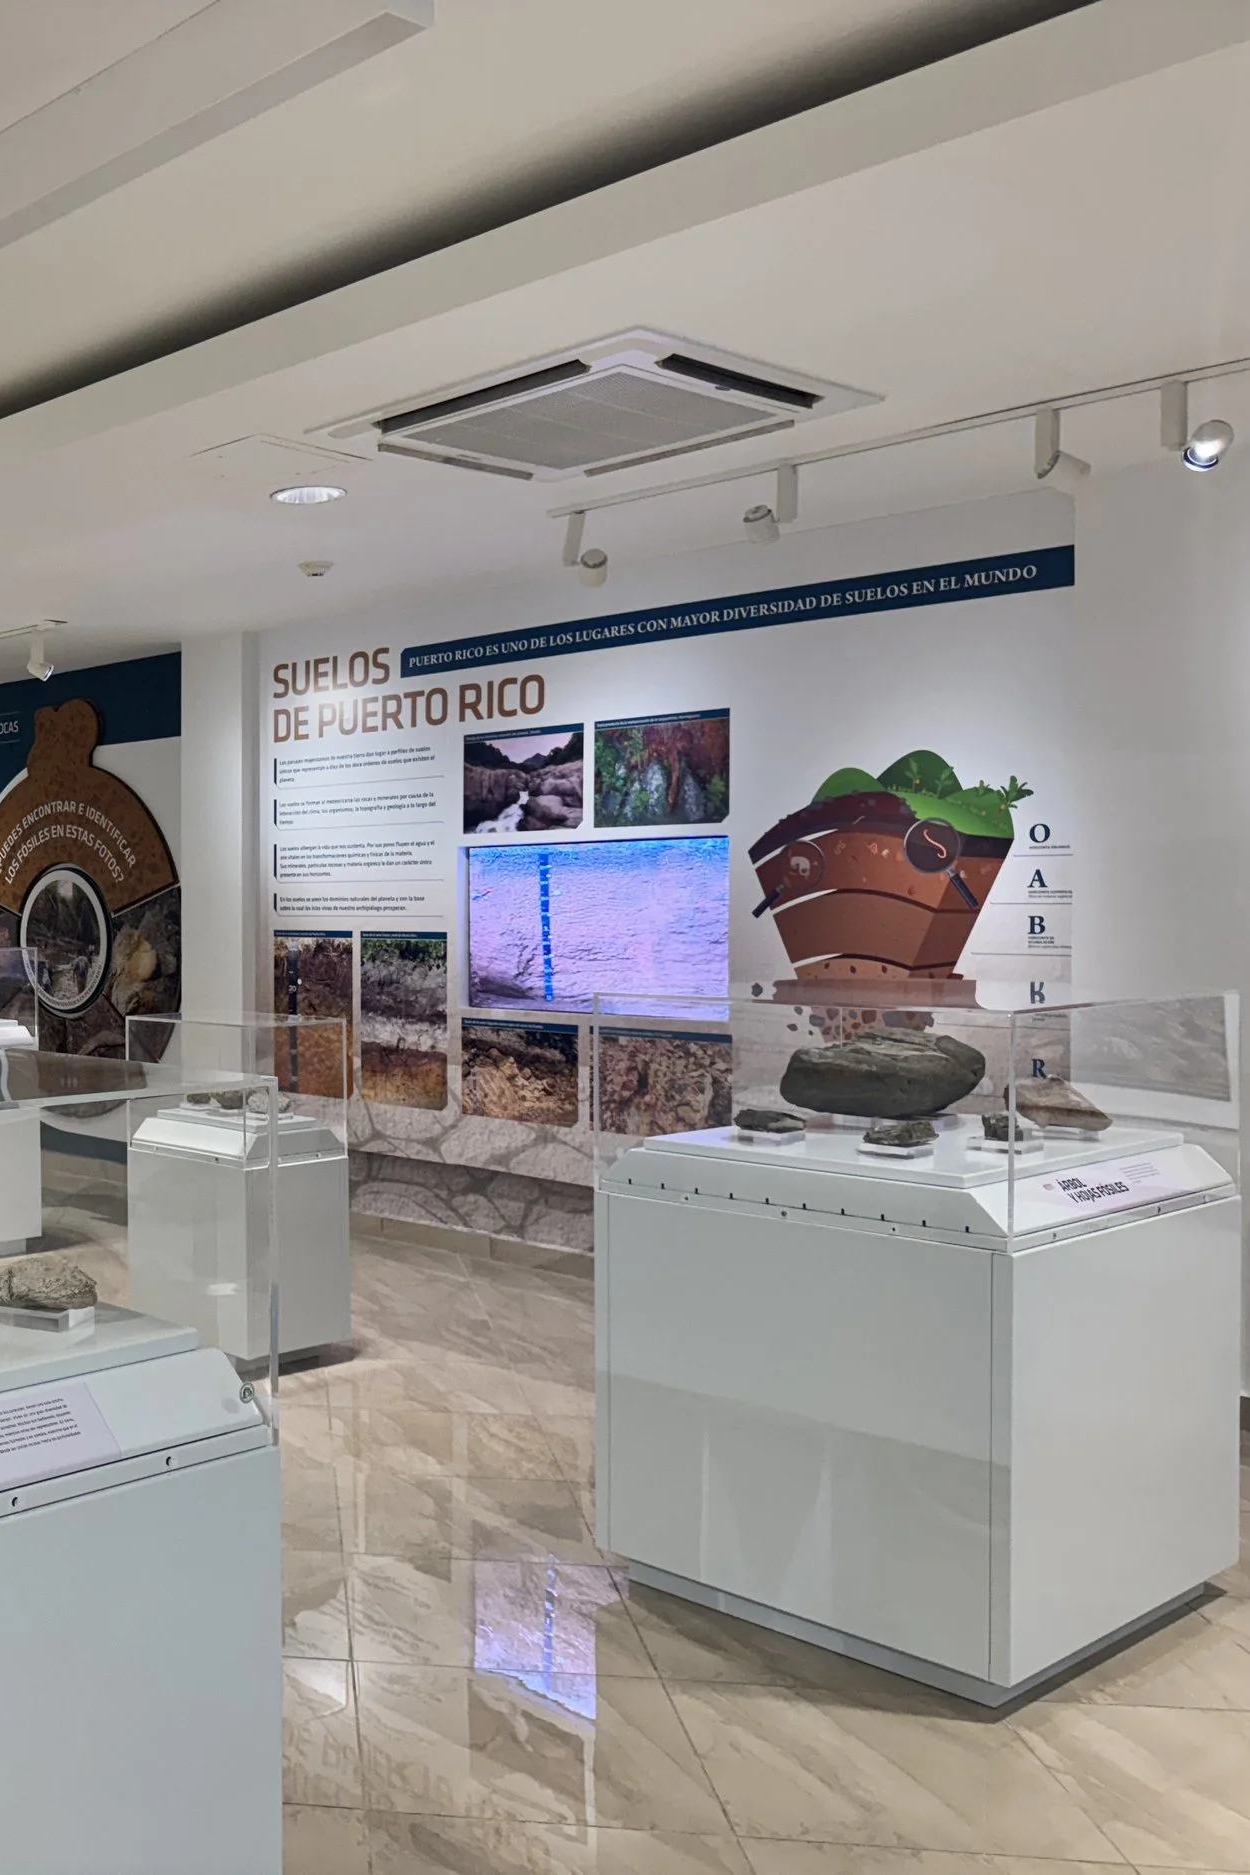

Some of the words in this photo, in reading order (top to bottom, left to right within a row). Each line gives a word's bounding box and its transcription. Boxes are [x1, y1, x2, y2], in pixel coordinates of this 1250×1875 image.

[409, 651, 452, 668] PUERTO
[455, 647, 483, 661] RICO
[486, 644, 499, 656] ES
[501, 639, 528, 654] UNO
[530, 636, 547, 649] DE
[550, 633, 573, 647] LOS
[576, 623, 634, 643] LUGARES
[638, 620, 667, 635] CON
[670, 611, 720, 630] MAYOR
[723, 598, 816, 621] DIVERSIDAD
[820, 593, 842, 608] DE
[846, 583, 908, 604] SUELOS
[913, 579, 935, 595] EN
[939, 577, 960, 591] EL
[964, 564, 1036, 588] MUNDO
[273, 647, 390, 699] SUELOS
[273, 706, 309, 743] DE
[318, 687, 448, 738] PUERTO
[458, 674, 545, 722] RICO
[22, 800, 76, 829] ENCONTRAR
[79, 804, 84, 815] E
[86, 806, 136, 868] IDENTIFICAR
[1029, 824, 1050, 843] O
[5, 859, 20, 884] LOS
[17, 827, 51, 863] FÓSILES
[52, 824, 64, 838] EN
[66, 824, 95, 847] ESTAS
[94, 839, 124, 883] FOTOS?
[1027, 869, 1048, 888] A
[1028, 916, 1045, 934] B
[1032, 1058, 1046, 1079] R
[1055, 1178, 1087, 1192] ÁRBOL
[1067, 1193, 1079, 1203] Y
[1078, 1187, 1102, 1202] HOJAS
[1096, 1181, 1130, 1197] FÓSILES
